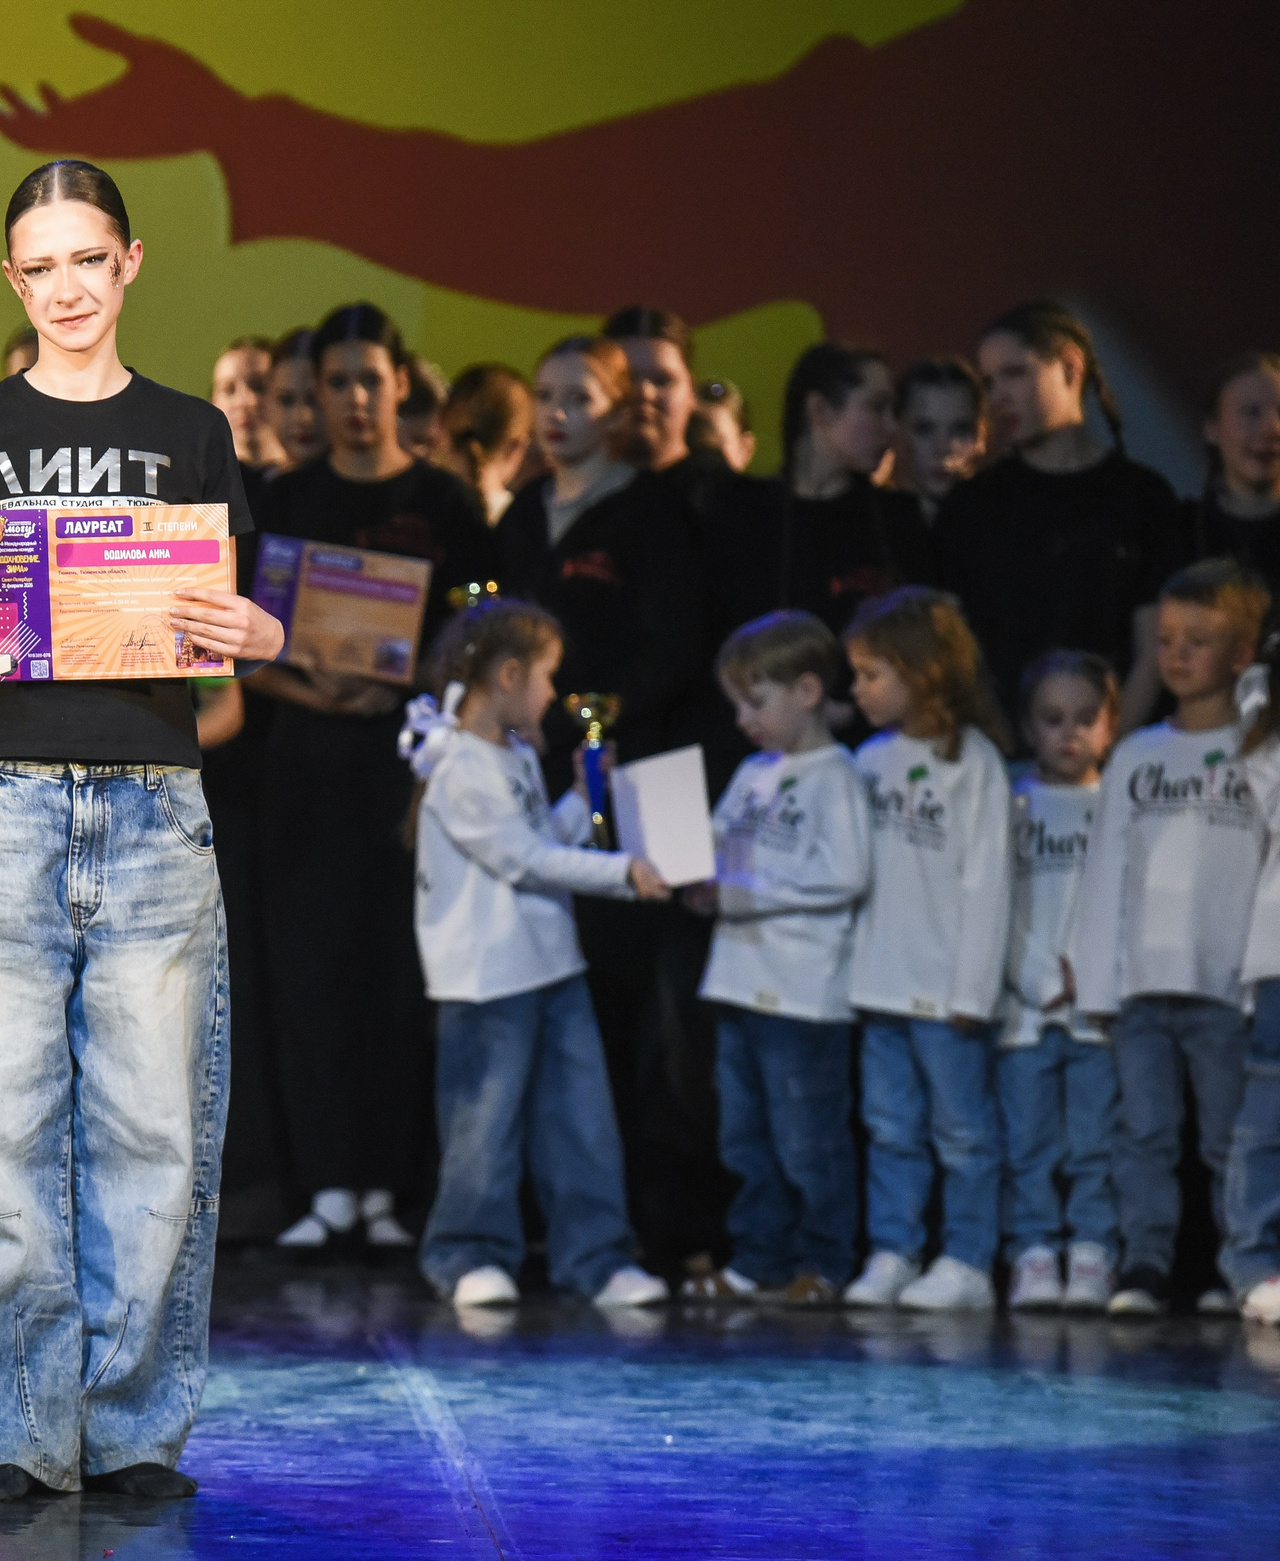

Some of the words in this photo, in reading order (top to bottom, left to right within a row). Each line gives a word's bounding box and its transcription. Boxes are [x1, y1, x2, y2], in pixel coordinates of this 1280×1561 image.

[61, 500, 103, 508] СТУДИЯ
[64, 520, 124, 535] ЛАУРЕАТ
[157, 521, 198, 532] СТЕПЕНИ
[103, 549, 148, 561] ВОДИЛОВА
[148, 548, 171, 559] АННА
